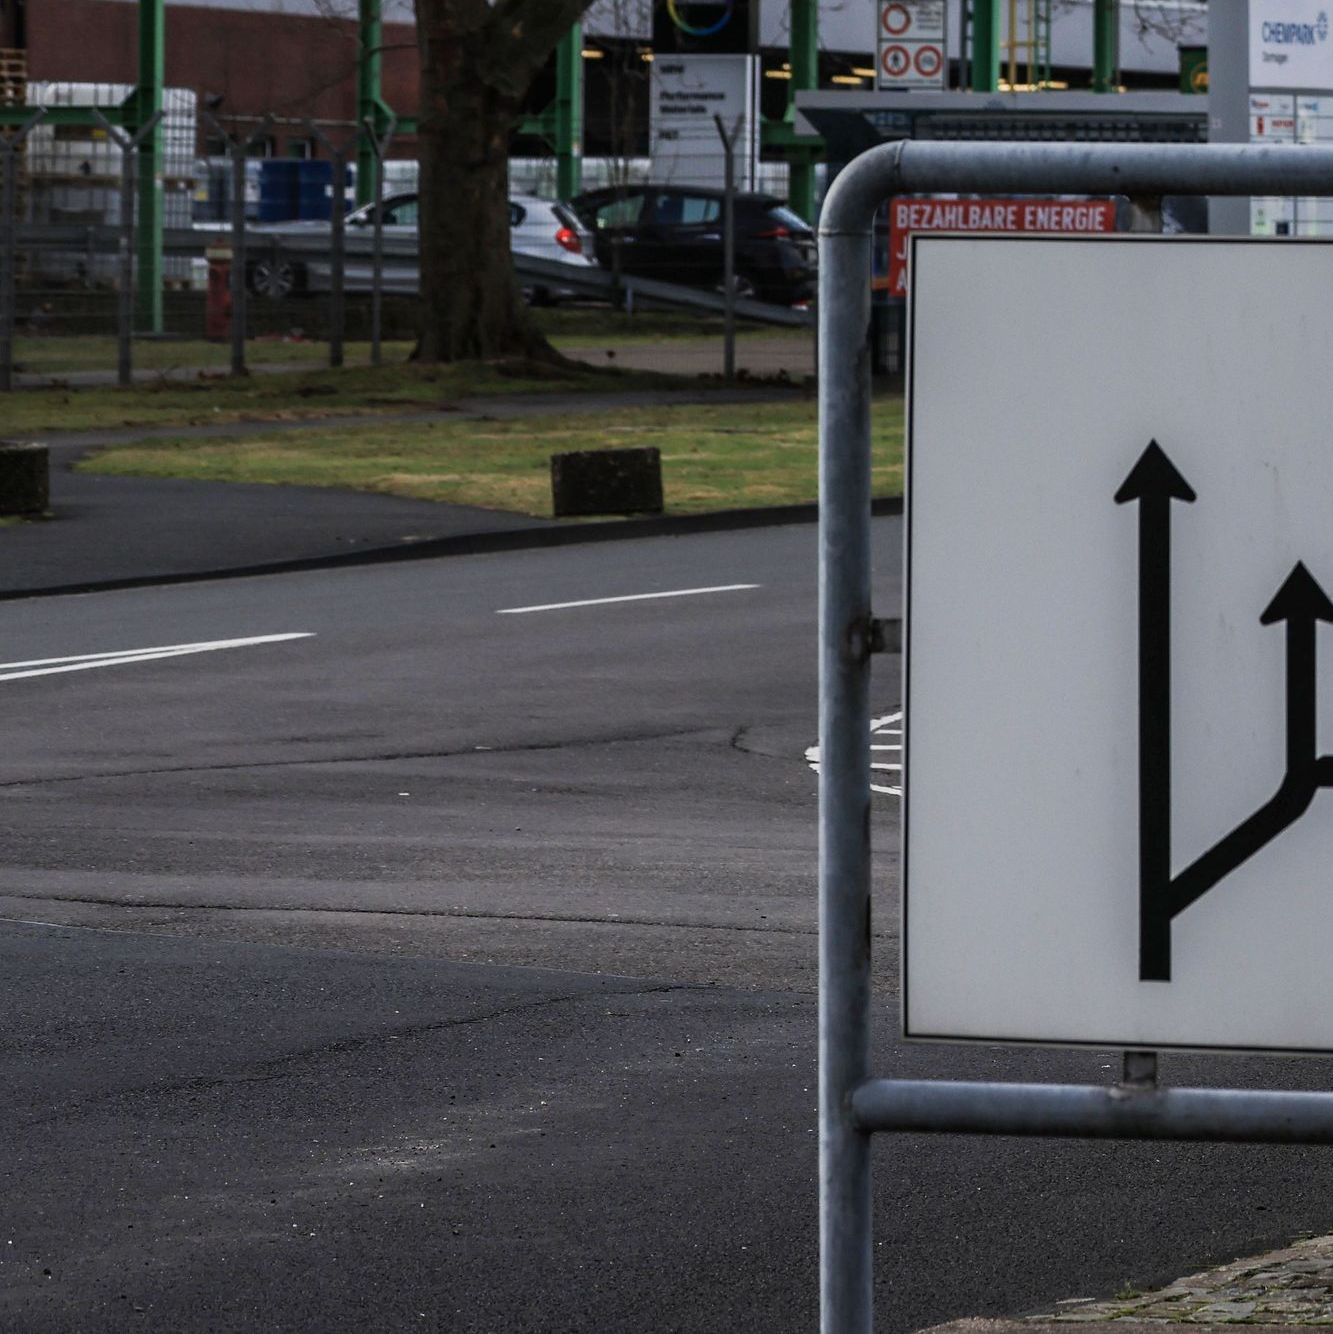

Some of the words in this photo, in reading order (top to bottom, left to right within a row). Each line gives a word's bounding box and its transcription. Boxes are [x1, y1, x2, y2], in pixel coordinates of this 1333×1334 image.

[1262, 21, 1316, 45] CHEMPARK
[896, 204, 1018, 230] BEZAHLBARE
[1024, 206, 1106, 231] ENERGIE
